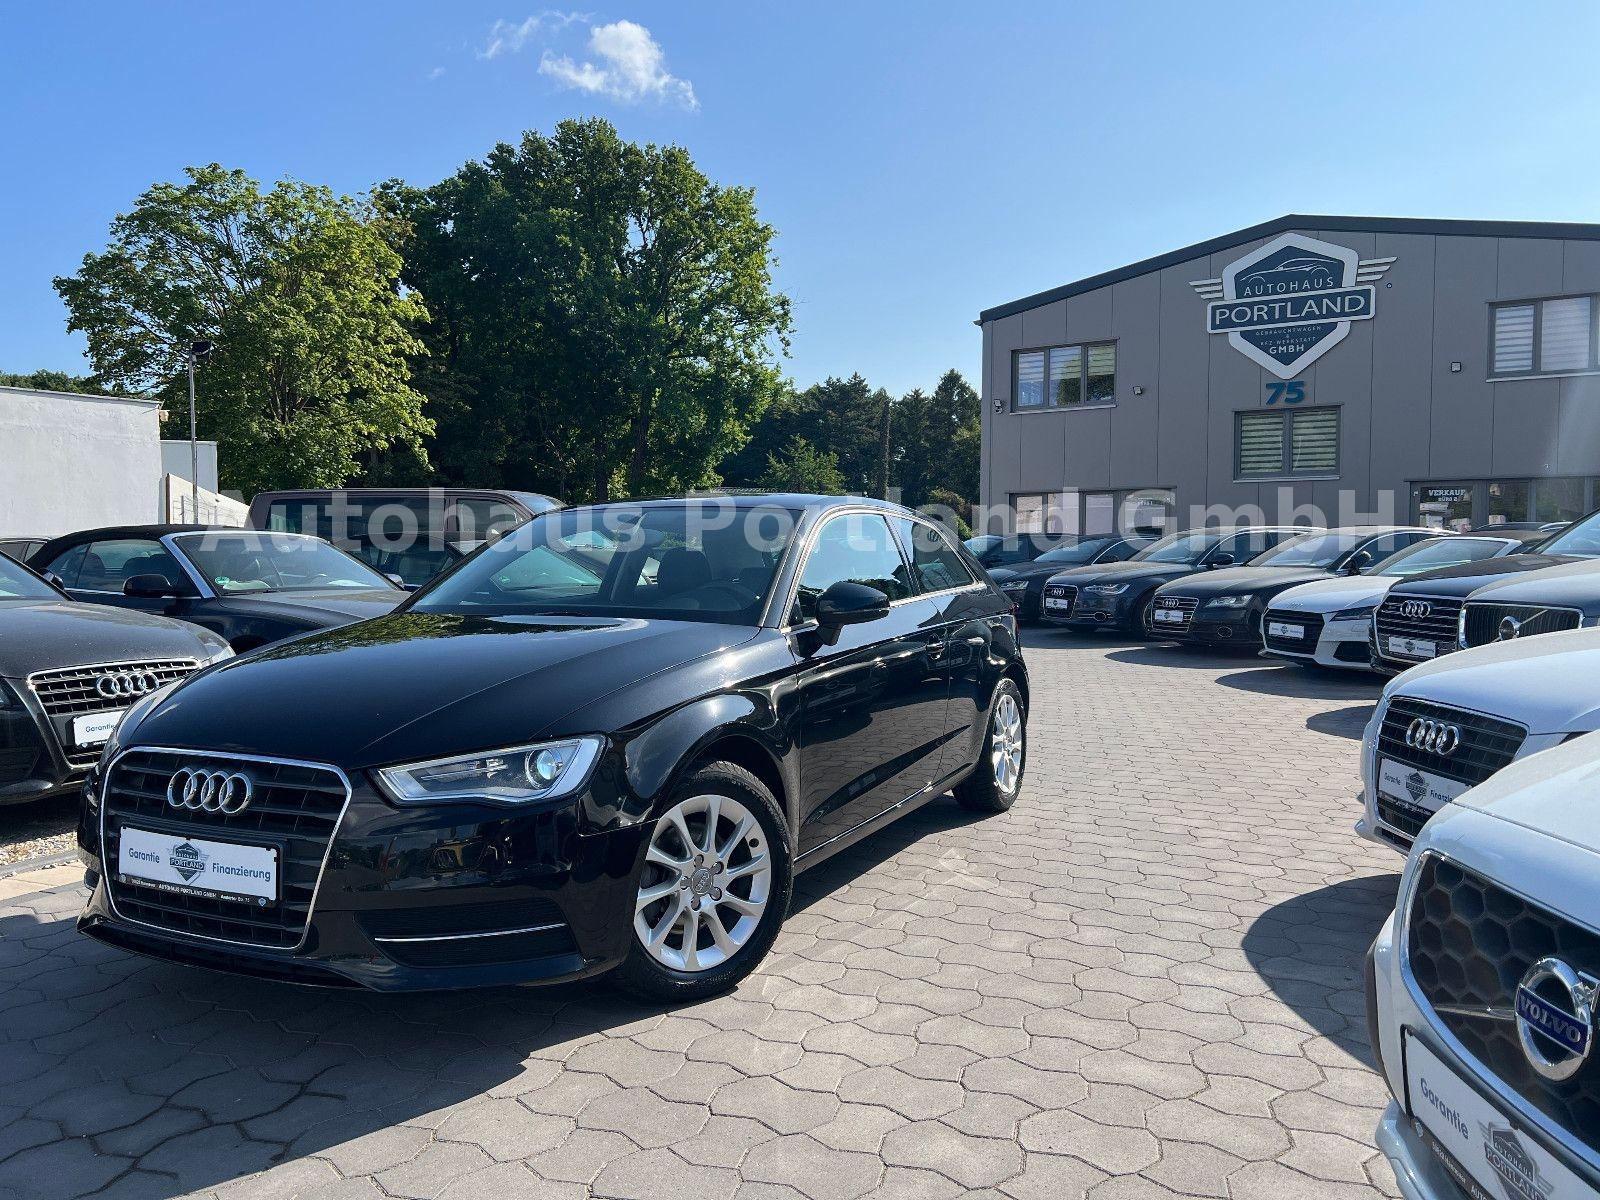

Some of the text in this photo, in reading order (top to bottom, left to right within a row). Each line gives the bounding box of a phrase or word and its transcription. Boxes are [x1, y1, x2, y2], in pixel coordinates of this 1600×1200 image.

[1243, 276, 1335, 296] AUTOHAUS
[1214, 294, 1366, 326] PORTLAND
[1269, 344, 1305, 354] GMBH
[1265, 380, 1306, 406] 75
[1428, 489, 1466, 497] VERKAUF
[128, 847, 160, 864] Garantie
[169, 857, 205, 871] PORTLAND
[212, 862, 271, 882] Finanzierung
[1520, 992, 1581, 1043] VOLVO
[1420, 1077, 1469, 1140] Garantie
